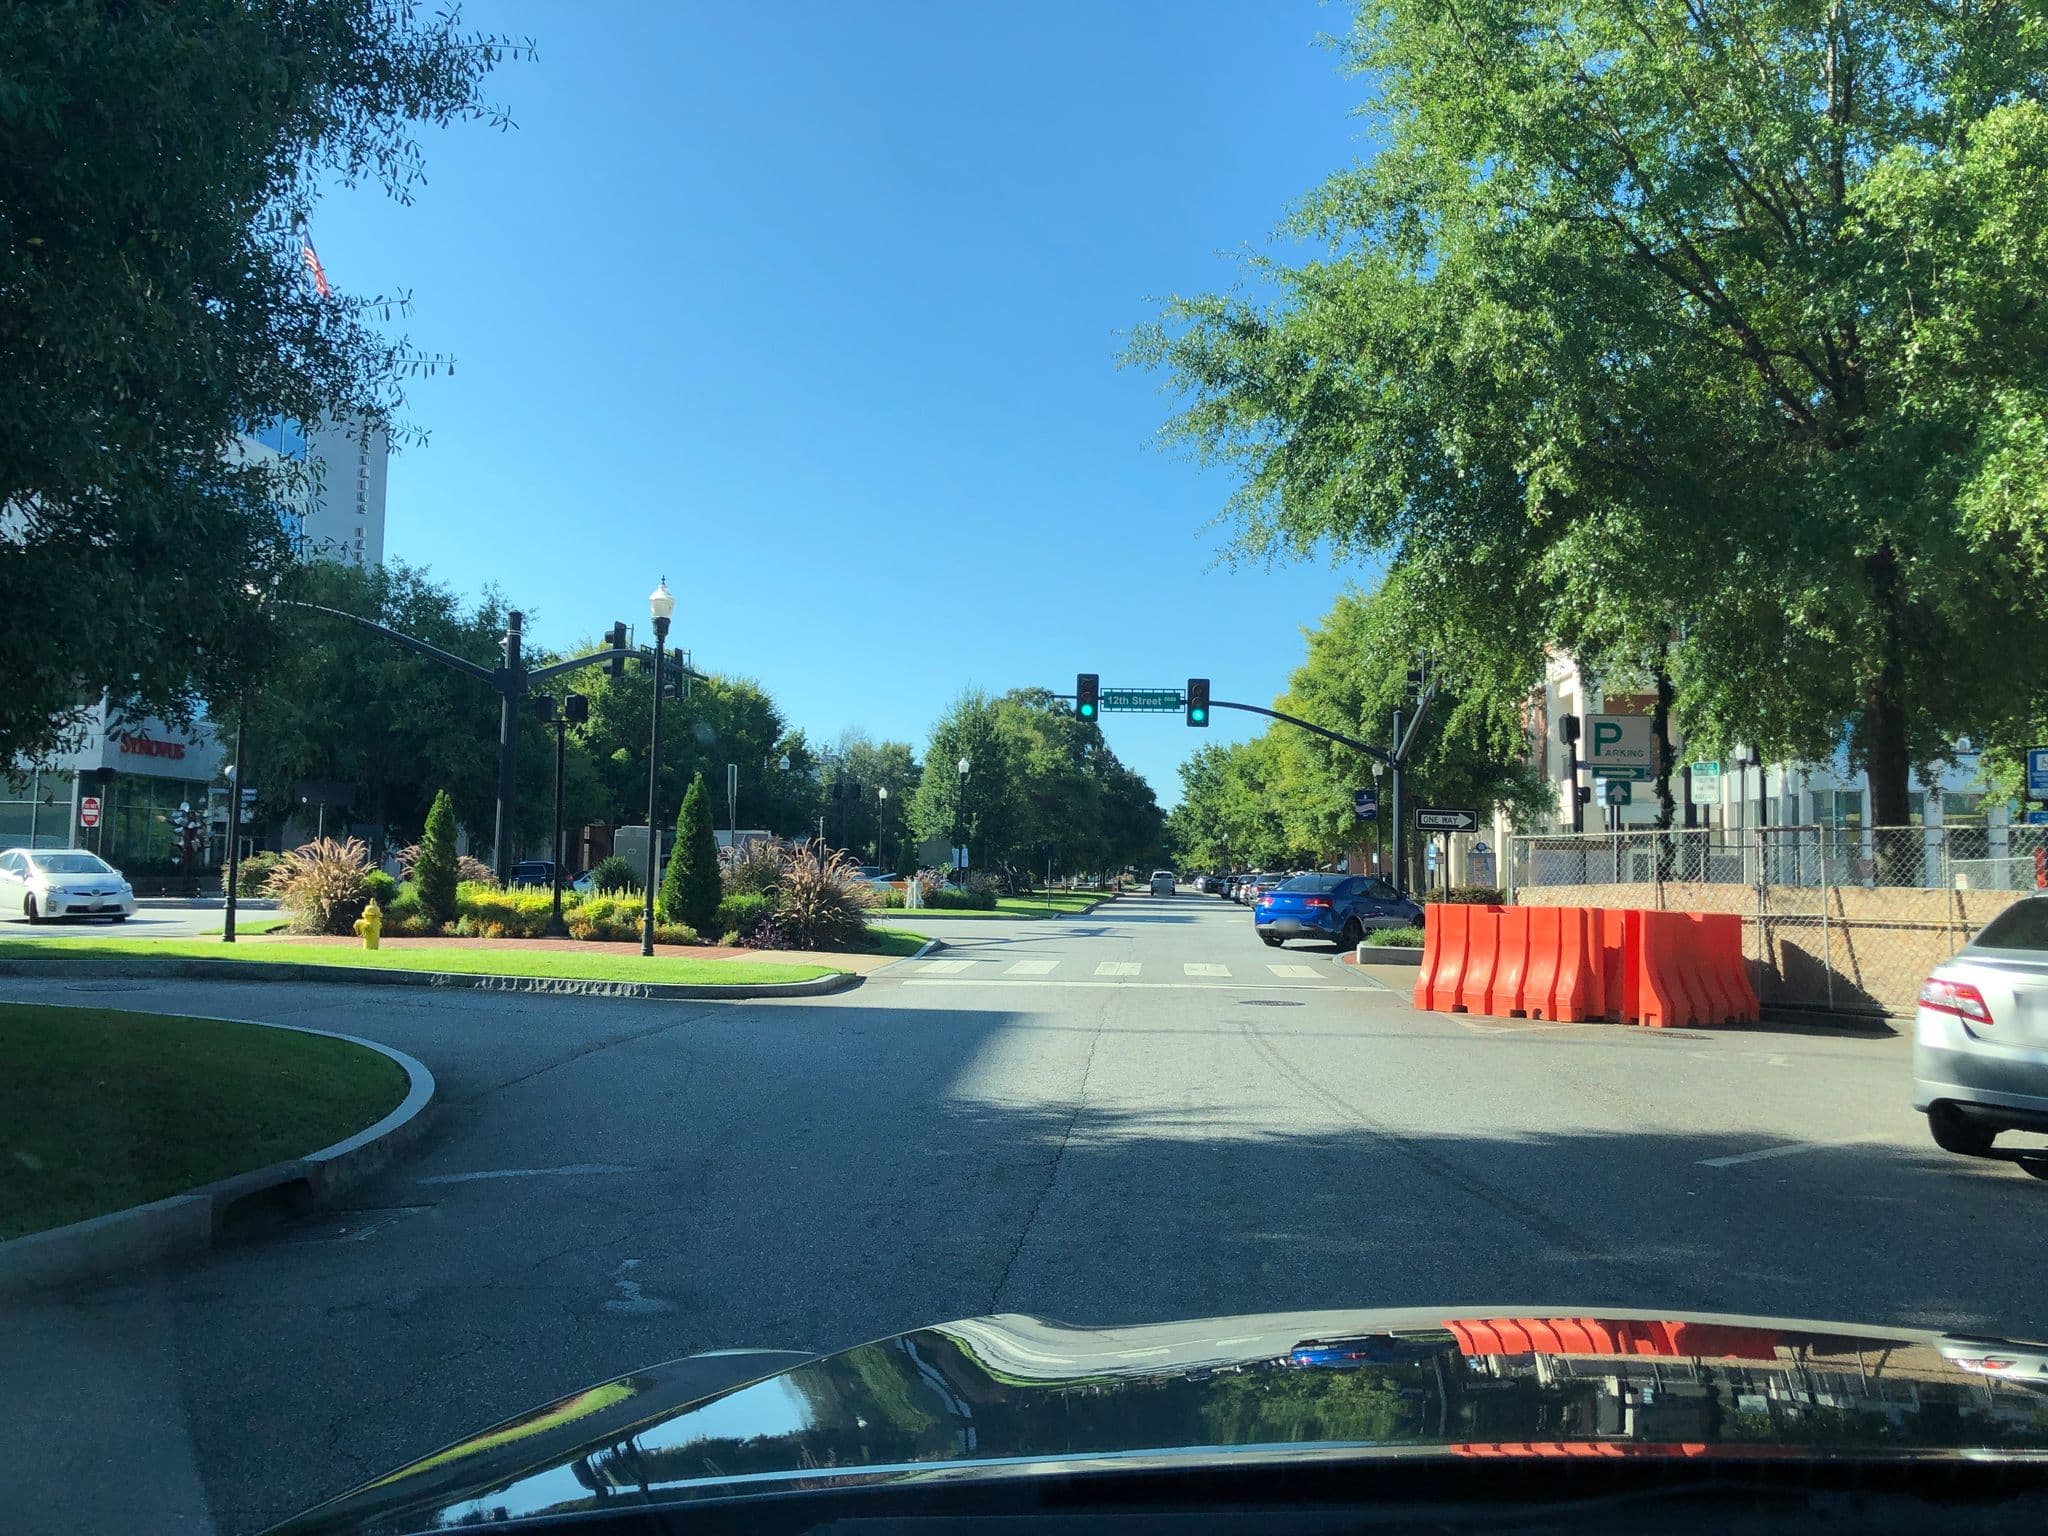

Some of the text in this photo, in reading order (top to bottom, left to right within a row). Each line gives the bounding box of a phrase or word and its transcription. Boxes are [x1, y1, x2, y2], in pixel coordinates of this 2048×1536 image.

[1107, 695, 1129, 705] 12th
[1131, 696, 1162, 706] Street
[1594, 722, 1645, 758] PARKING
[1423, 815, 1458, 825] ONE WAY
